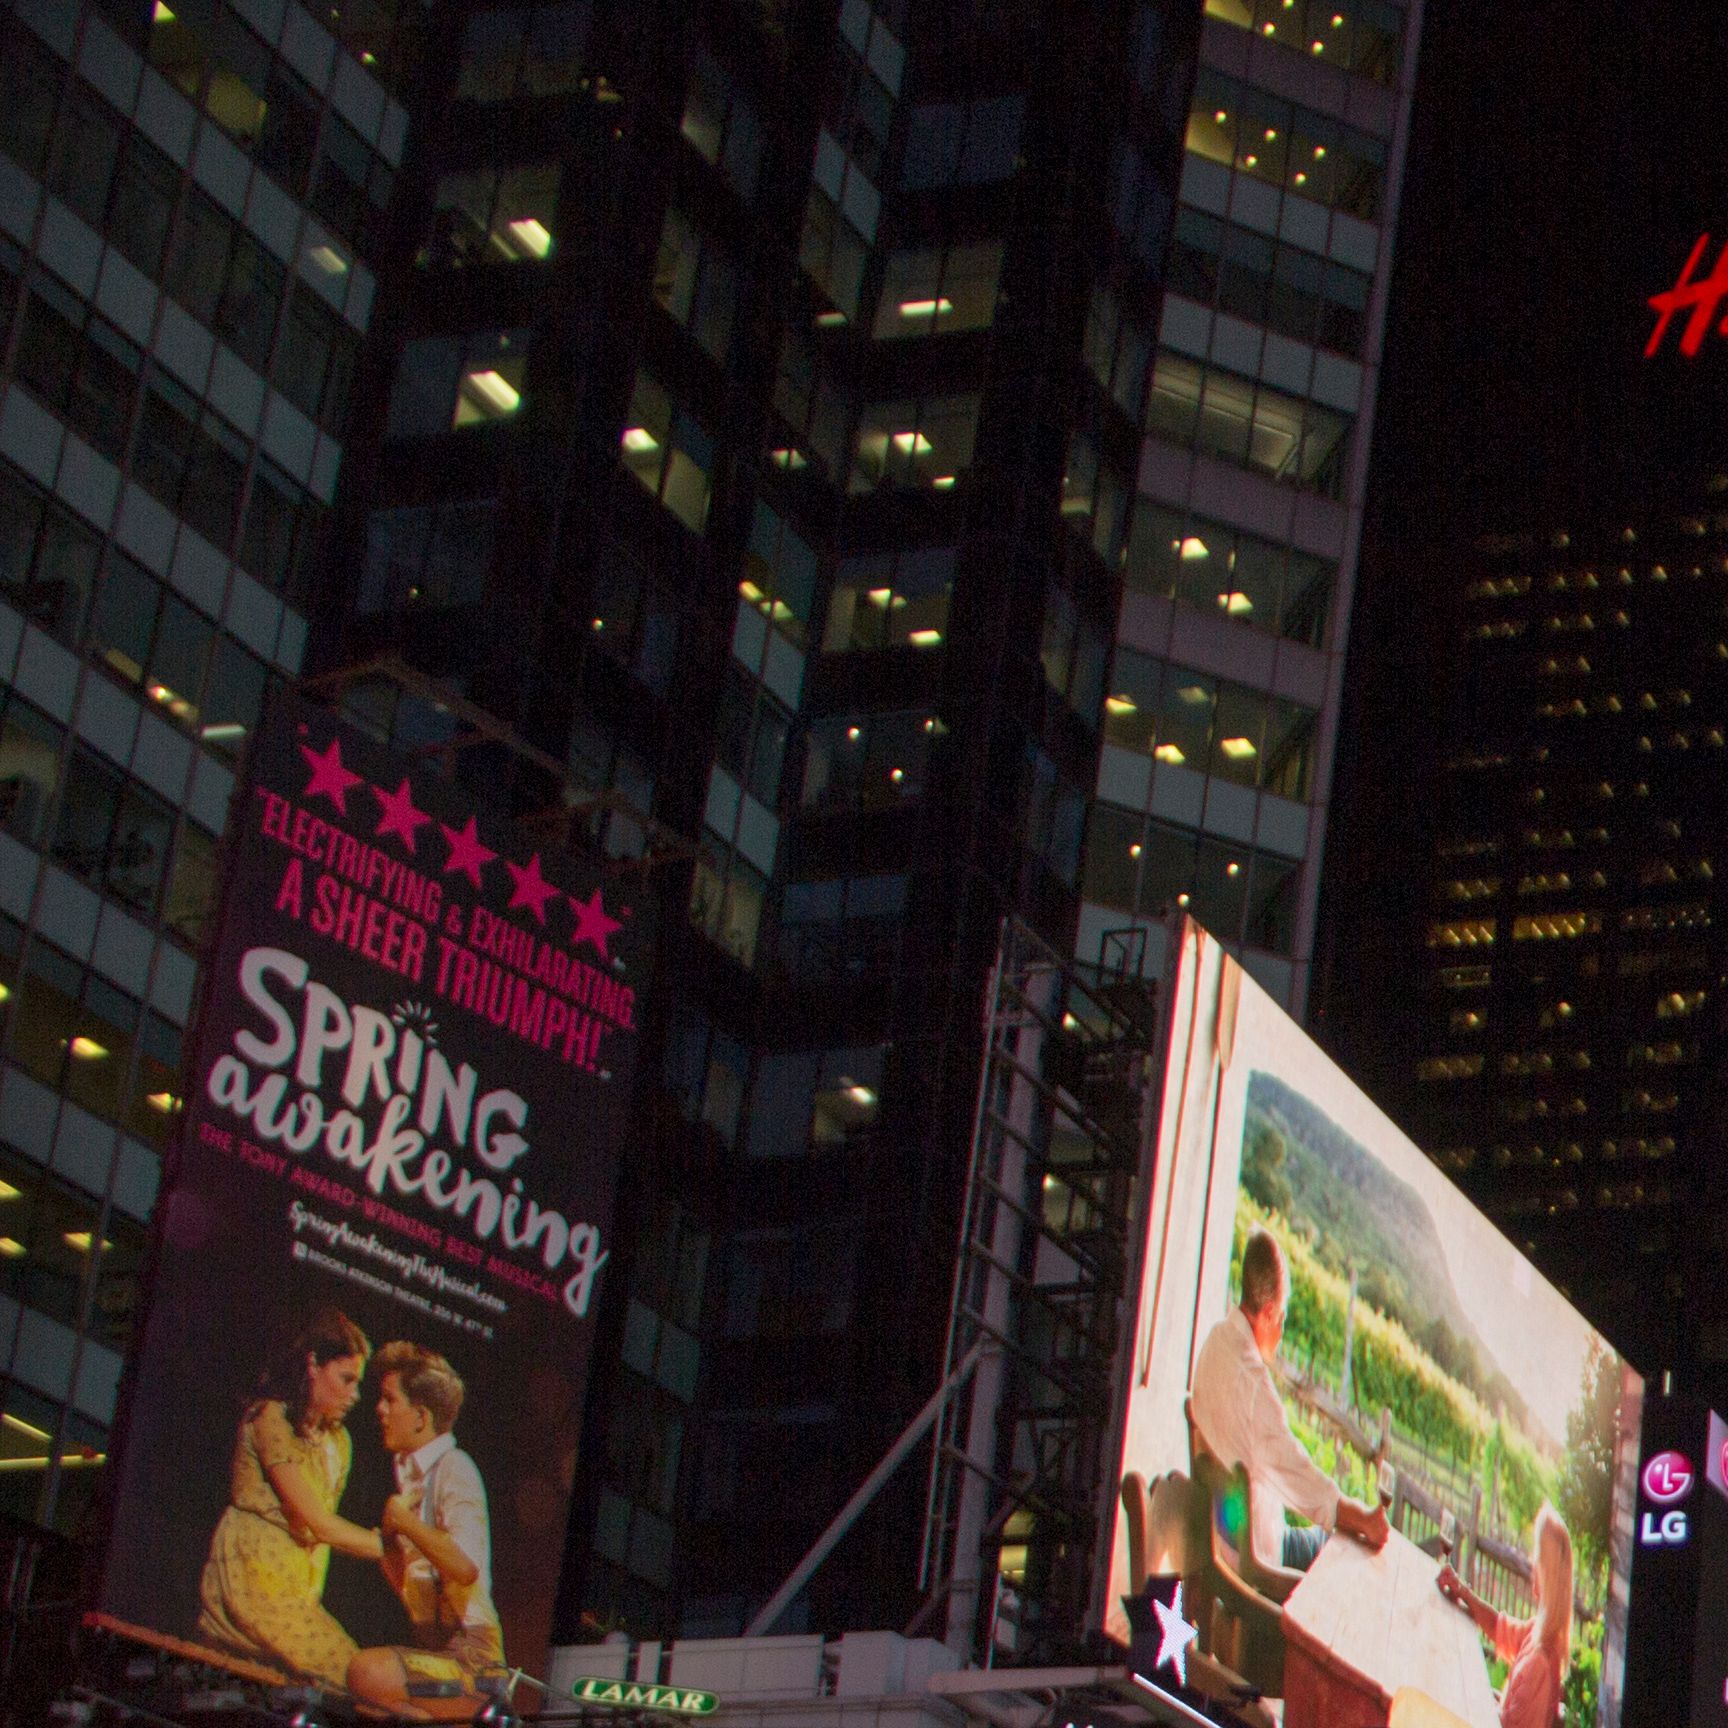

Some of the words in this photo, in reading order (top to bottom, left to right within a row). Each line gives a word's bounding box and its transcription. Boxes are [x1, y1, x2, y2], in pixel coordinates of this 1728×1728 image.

[276, 857, 301, 918] A
[310, 873, 427, 983] SHEER
[233, 946, 530, 1170] SPRING
[206, 1055, 610, 1318] awakening
[1641, 1511, 1688, 1544] LG
[581, 1679, 707, 1711] LAMAR
